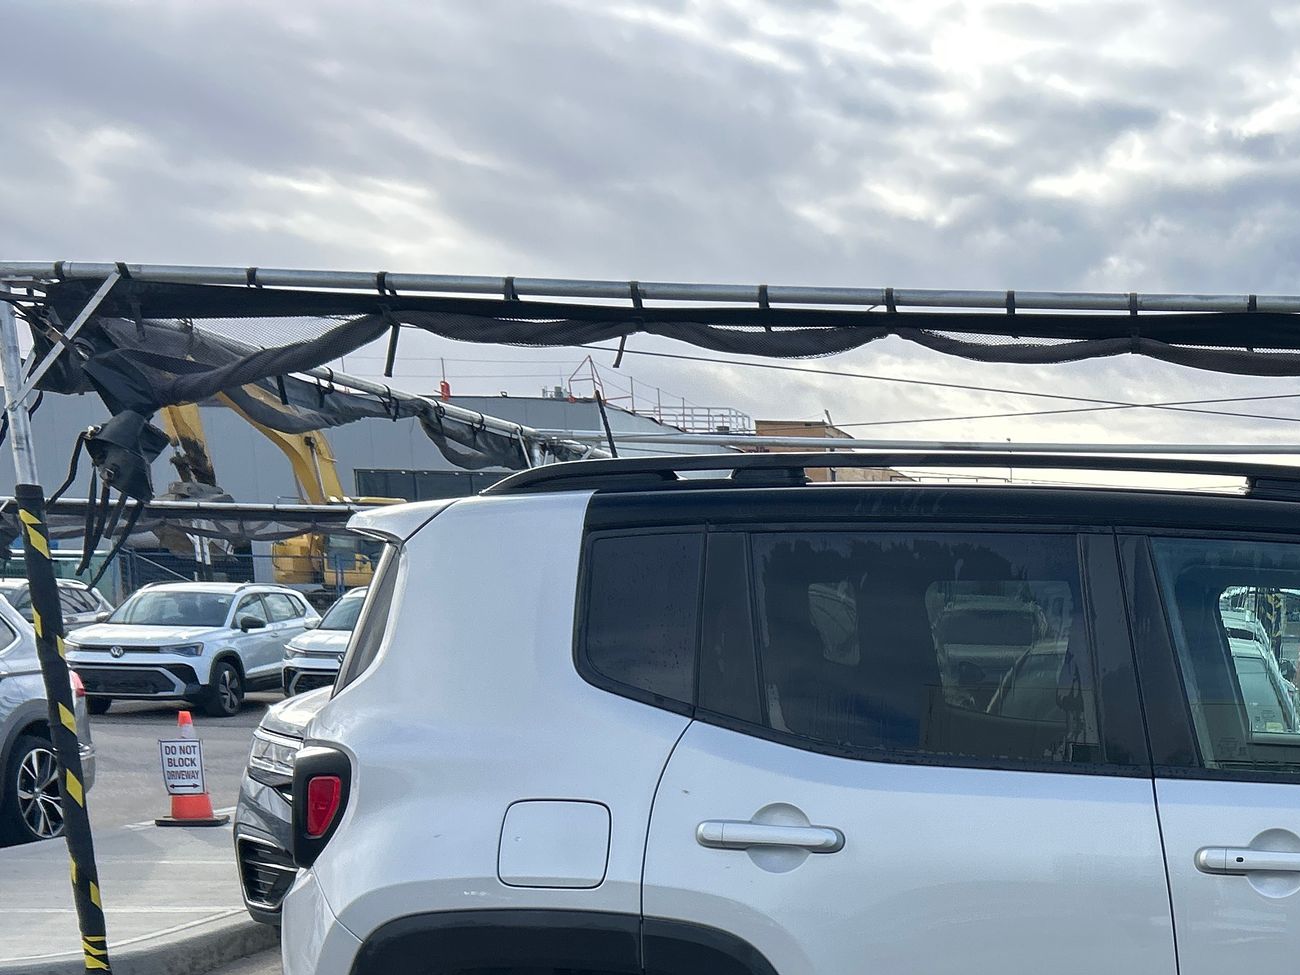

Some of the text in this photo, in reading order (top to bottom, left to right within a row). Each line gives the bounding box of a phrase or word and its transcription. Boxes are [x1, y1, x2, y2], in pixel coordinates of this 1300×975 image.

[165, 745, 198, 756] DO NOT
[167, 757, 198, 767] BLOCK
[166, 770, 200, 780] DRIVEWAY
